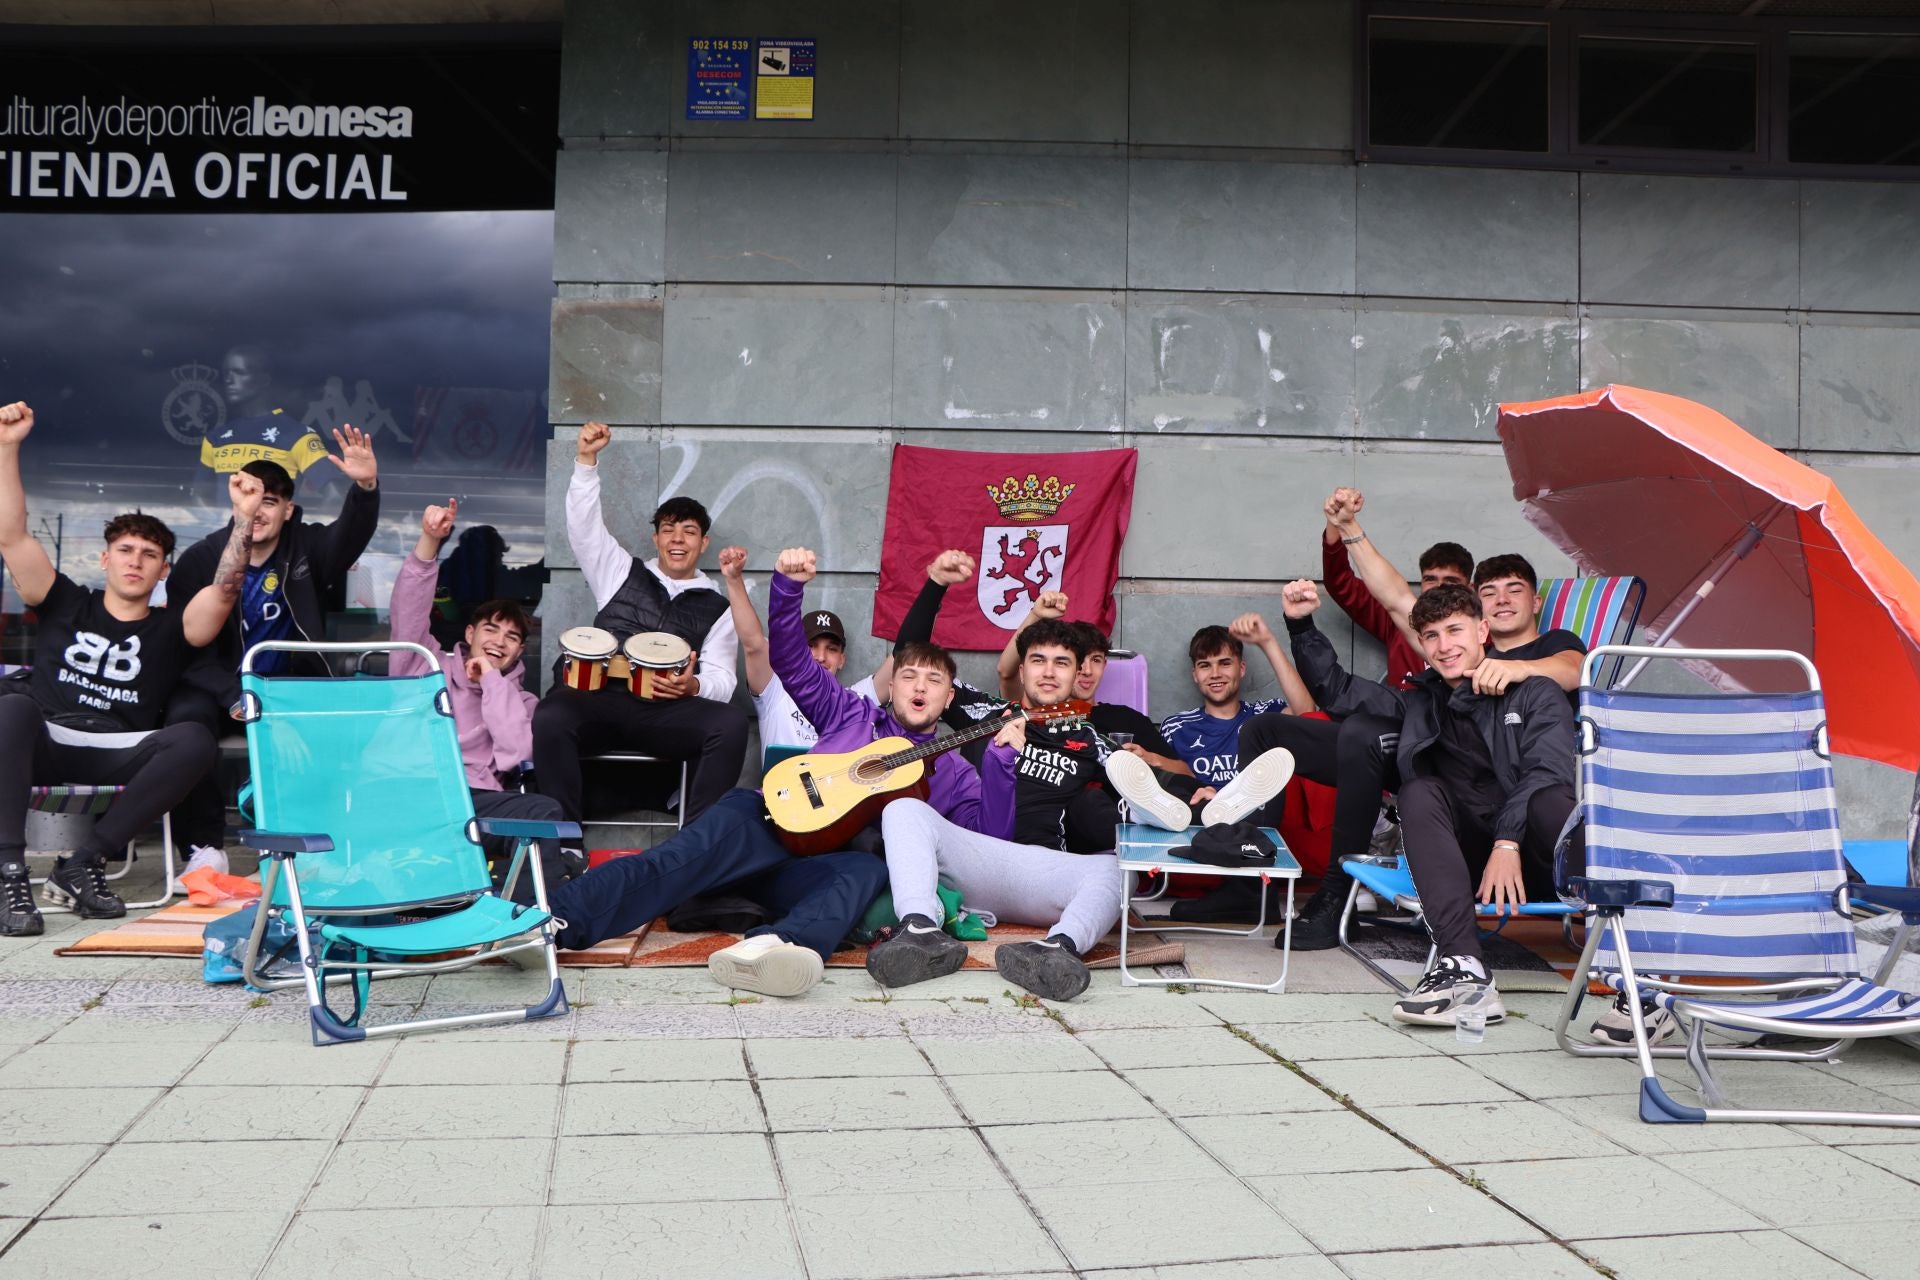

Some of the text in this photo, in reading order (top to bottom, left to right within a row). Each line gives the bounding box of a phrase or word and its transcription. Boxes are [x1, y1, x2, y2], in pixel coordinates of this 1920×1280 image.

[692, 40, 749, 50] 902 154 539
[0, 151, 408, 201] IENDA OFICIAL
[78, 694, 112, 710] PARIS
[1020, 743, 1079, 776] irates
[1020, 759, 1065, 787] BETTER
